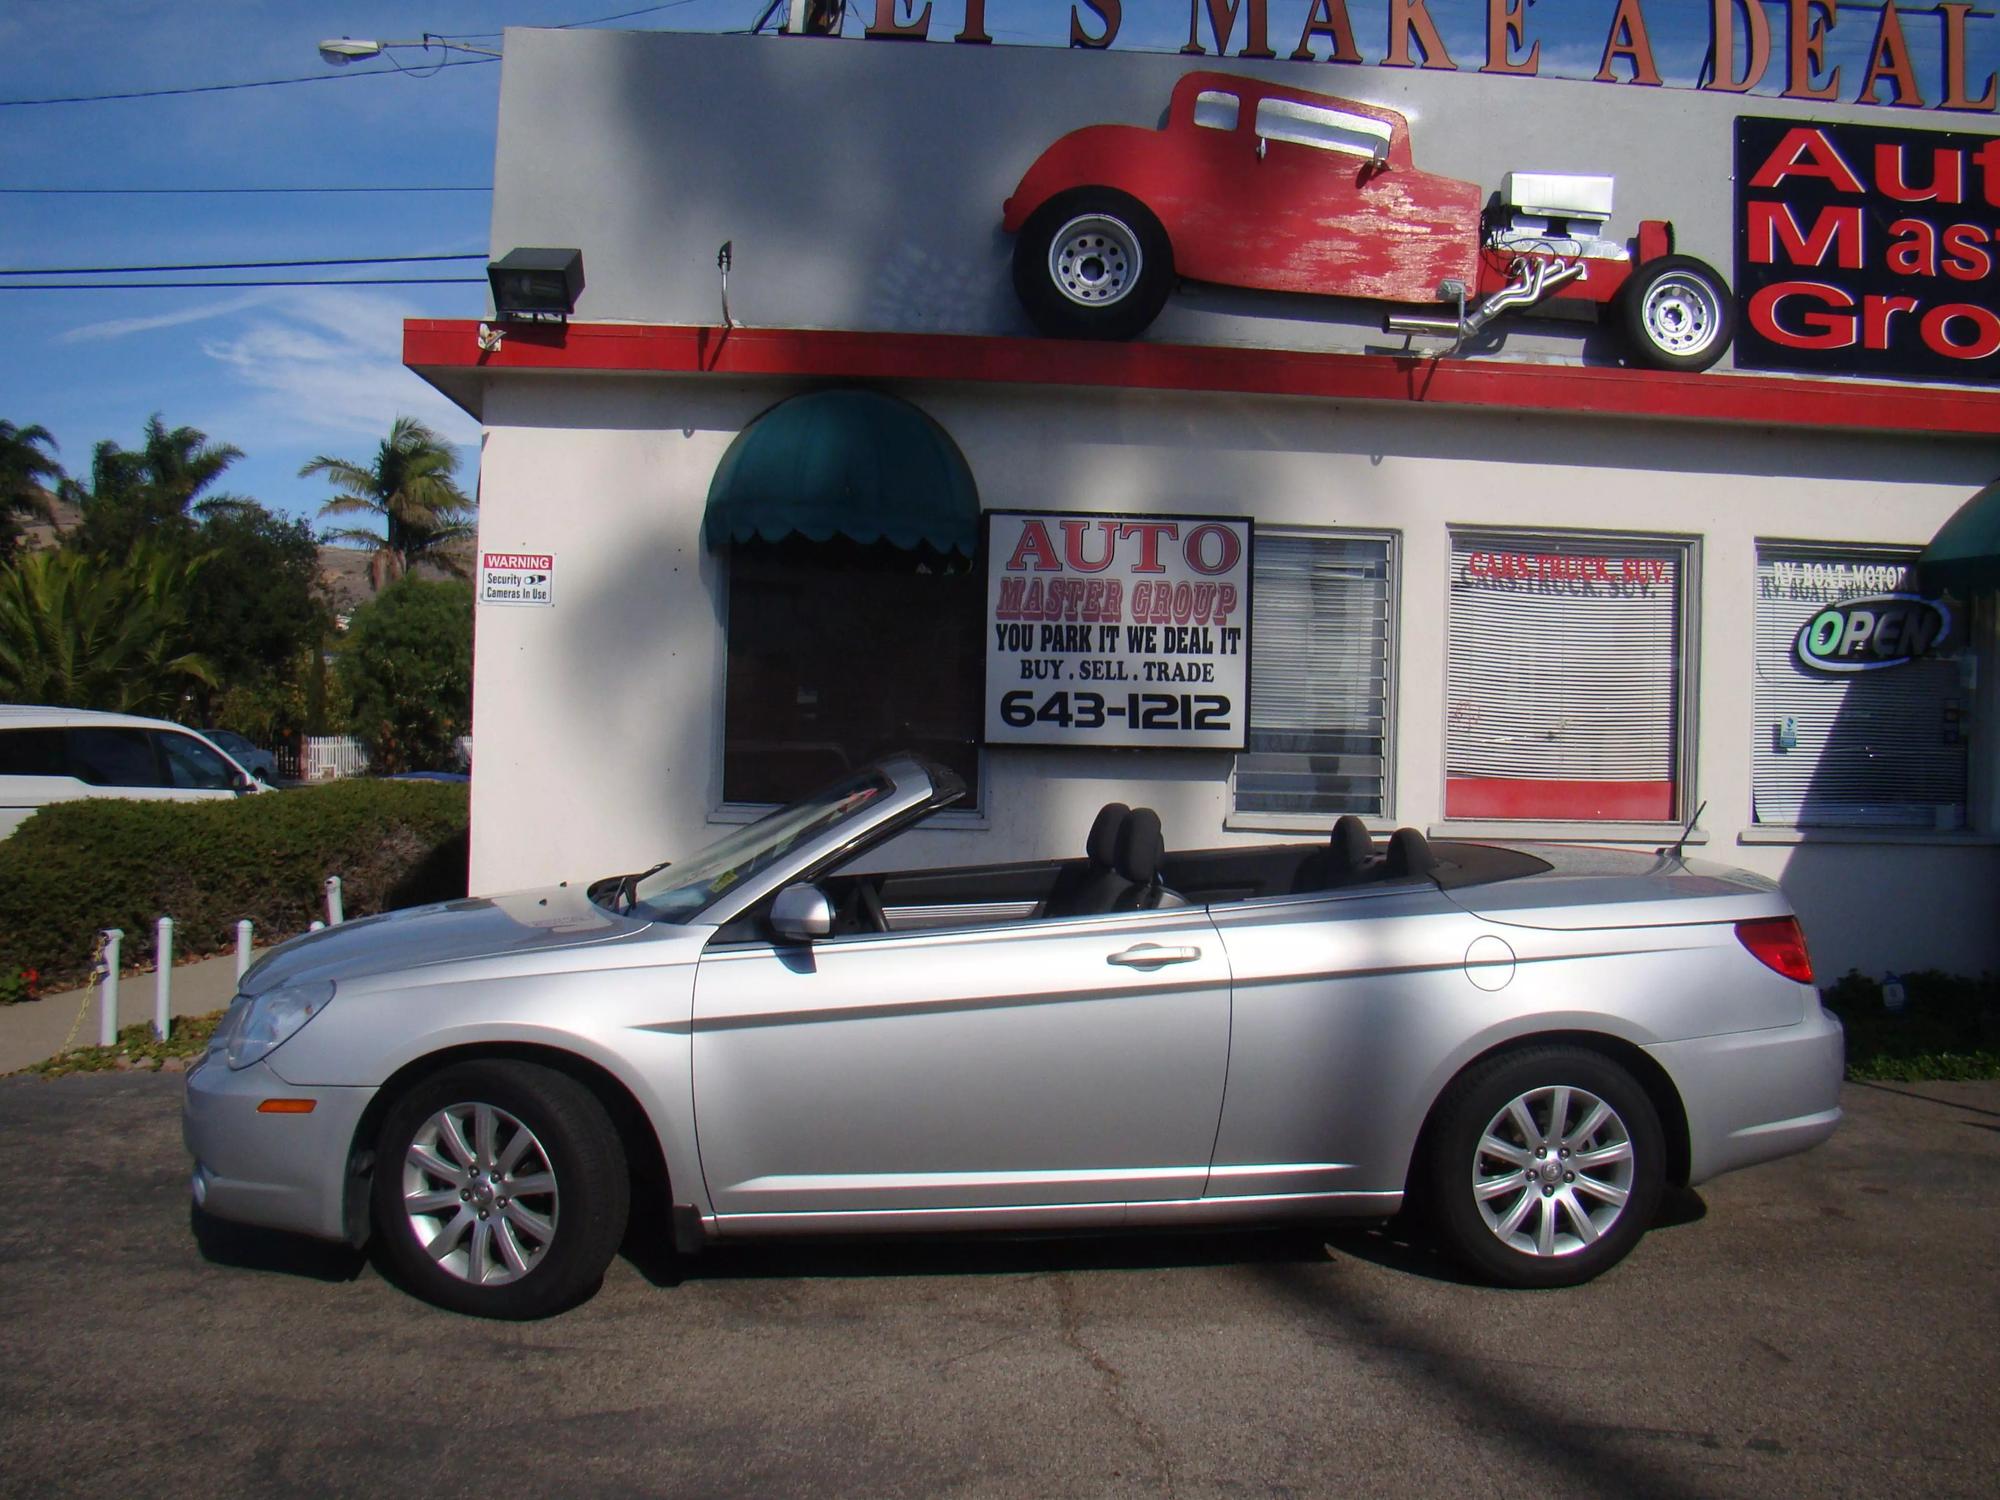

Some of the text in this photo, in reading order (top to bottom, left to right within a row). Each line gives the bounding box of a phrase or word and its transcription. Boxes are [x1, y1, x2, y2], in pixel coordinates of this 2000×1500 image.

[1594, 0, 1662, 87] A
[1701, 0, 1997, 112] DEAL
[1747, 201, 2000, 282] Mas
[487, 555, 550, 569] WARNING
[1006, 520, 1242, 576] AUTO
[487, 572, 522, 587] Security
[487, 587, 547, 600] Cameras In Use
[996, 577, 1238, 626] MASTER GROUP
[996, 623, 1241, 655] YOU PARK IT WE DEAL IT
[1808, 610, 1936, 656] OPEN
[1143, 662, 1215, 682] TRADE
[1000, 690, 1231, 731] 643-1212
